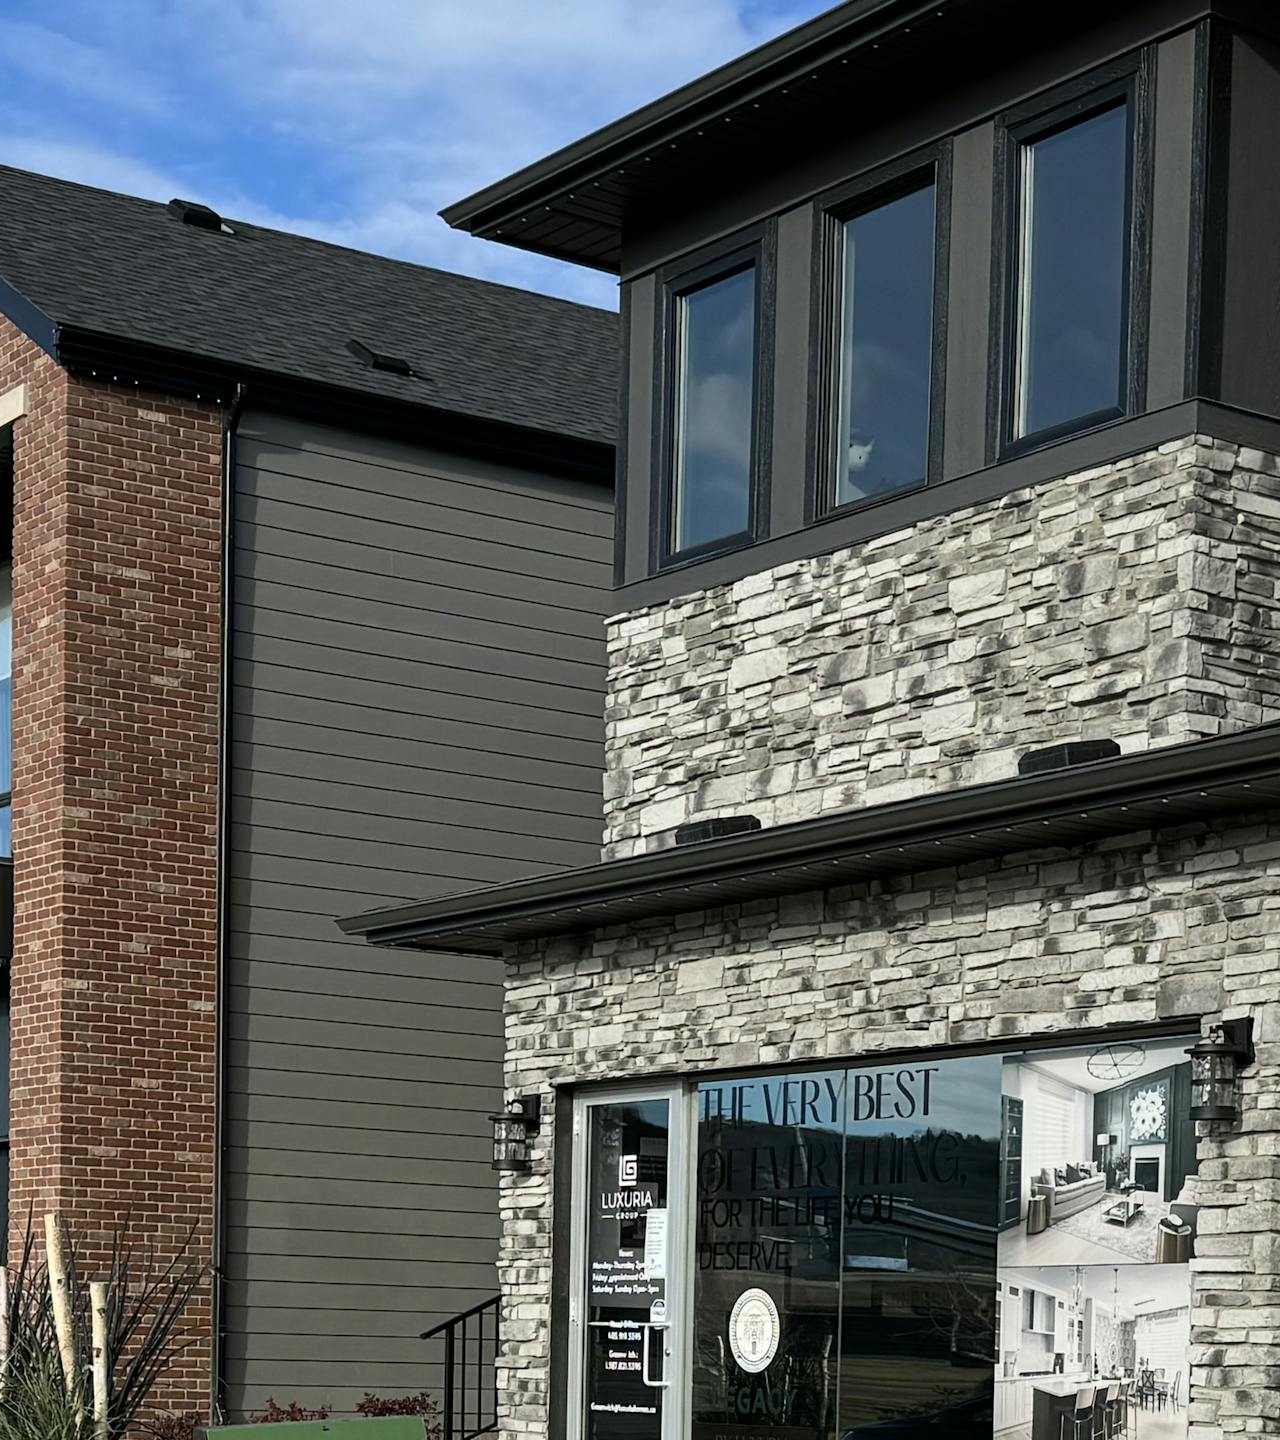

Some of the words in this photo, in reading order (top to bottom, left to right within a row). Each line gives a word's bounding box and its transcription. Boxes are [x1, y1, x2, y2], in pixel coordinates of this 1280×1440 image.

[698, 1085, 754, 1130] THE
[762, 1076, 845, 1127] VERY
[853, 1068, 939, 1122] BEST
[699, 1147, 745, 1194] OF
[601, 1190, 653, 1209] LUXURIA
[615, 1211, 639, 1220] GROUP
[700, 1199, 742, 1228] FOR
[748, 1197, 791, 1227] THE
[843, 1193, 894, 1224] YOU
